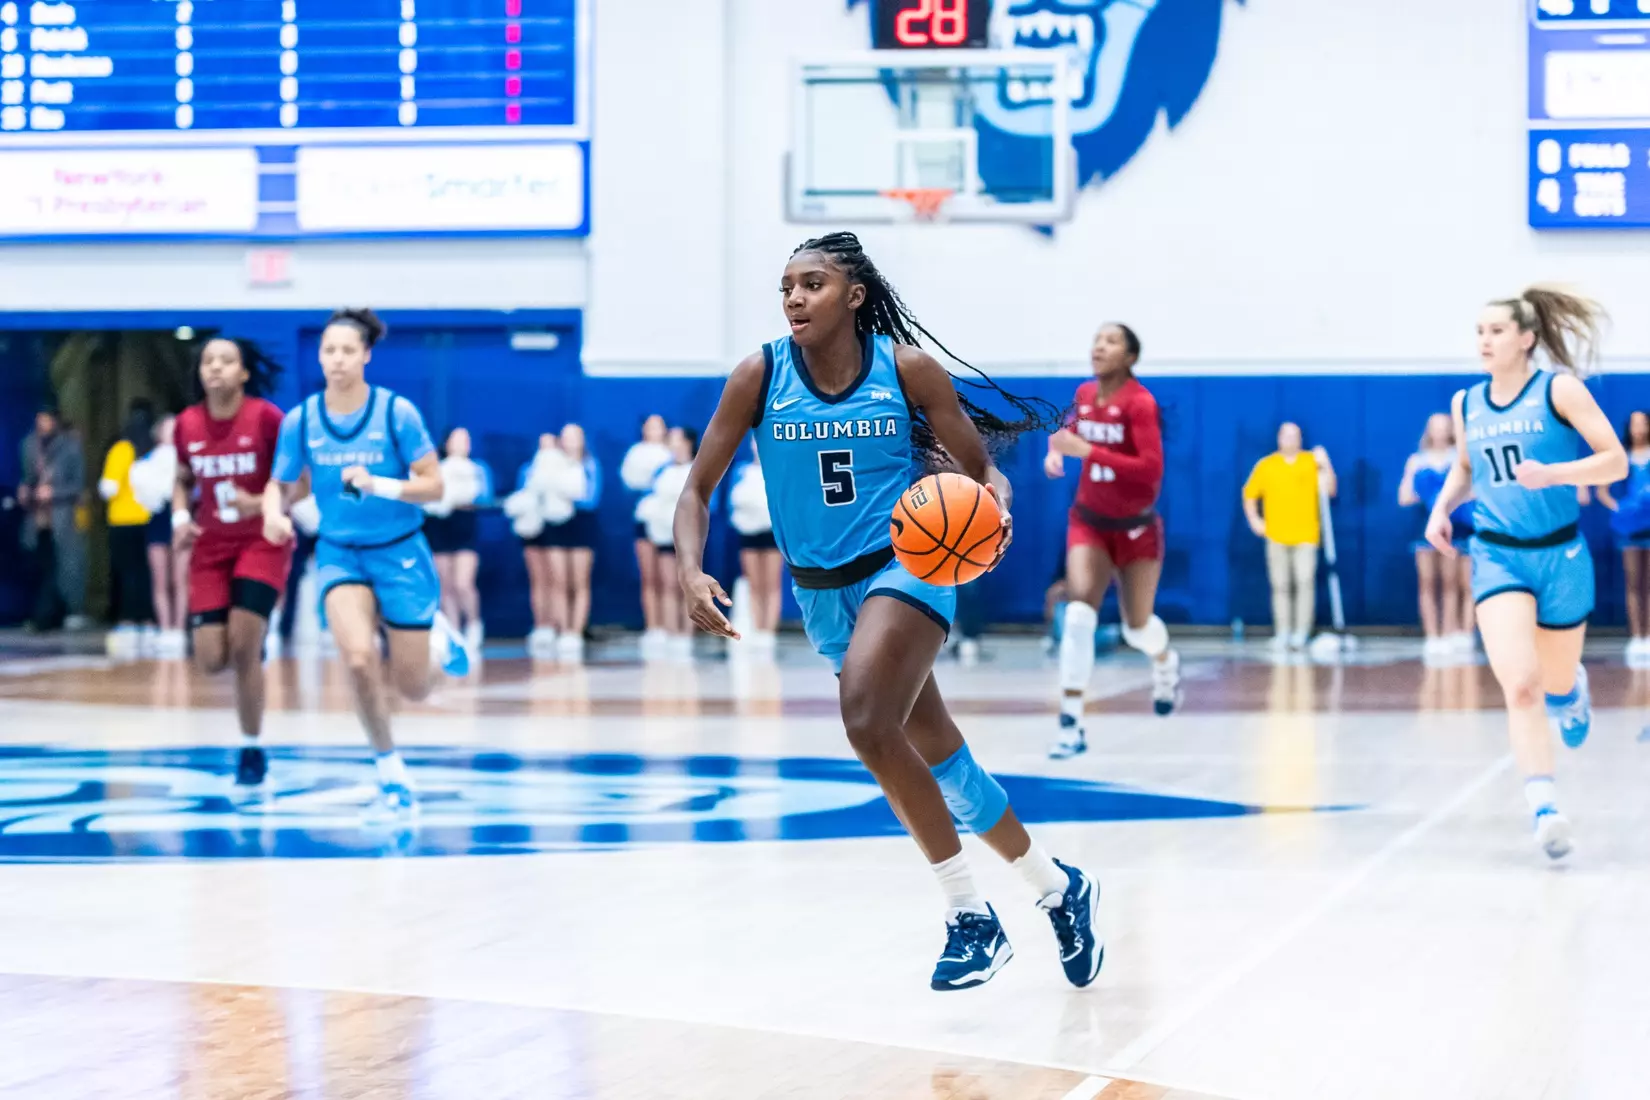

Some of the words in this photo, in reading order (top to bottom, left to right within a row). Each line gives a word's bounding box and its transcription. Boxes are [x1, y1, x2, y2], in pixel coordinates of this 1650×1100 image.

[894, 0, 969, 45] 28
[773, 418, 898, 441] COLUMBIA
[189, 452, 257, 478] PENN
[817, 449, 857, 507] 5
[1482, 442, 1524, 485] 10
